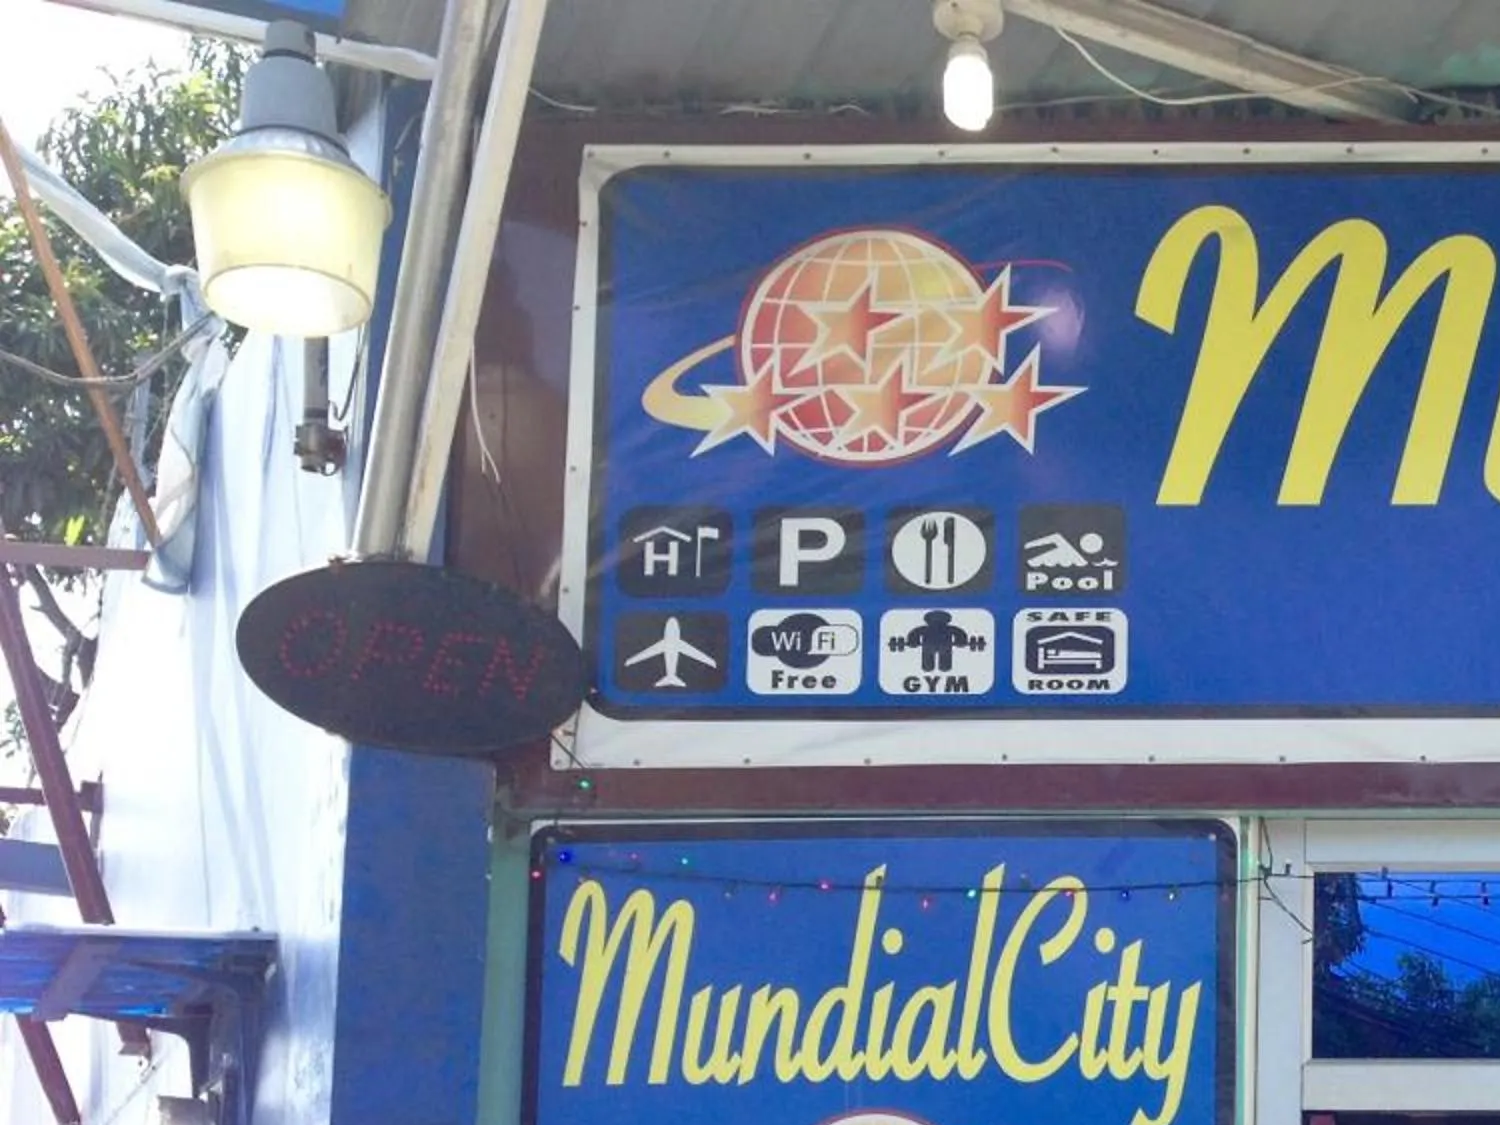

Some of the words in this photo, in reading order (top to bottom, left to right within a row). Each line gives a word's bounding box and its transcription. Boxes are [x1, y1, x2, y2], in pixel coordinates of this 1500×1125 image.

[778, 517, 847, 587] P
[1024, 570, 1114, 591] Pool
[1026, 610, 1112, 623] SAFE
[278, 608, 548, 703] OPEN
[770, 669, 837, 690] Free
[903, 675, 970, 694] GYM
[1027, 679, 1111, 691] ROOM
